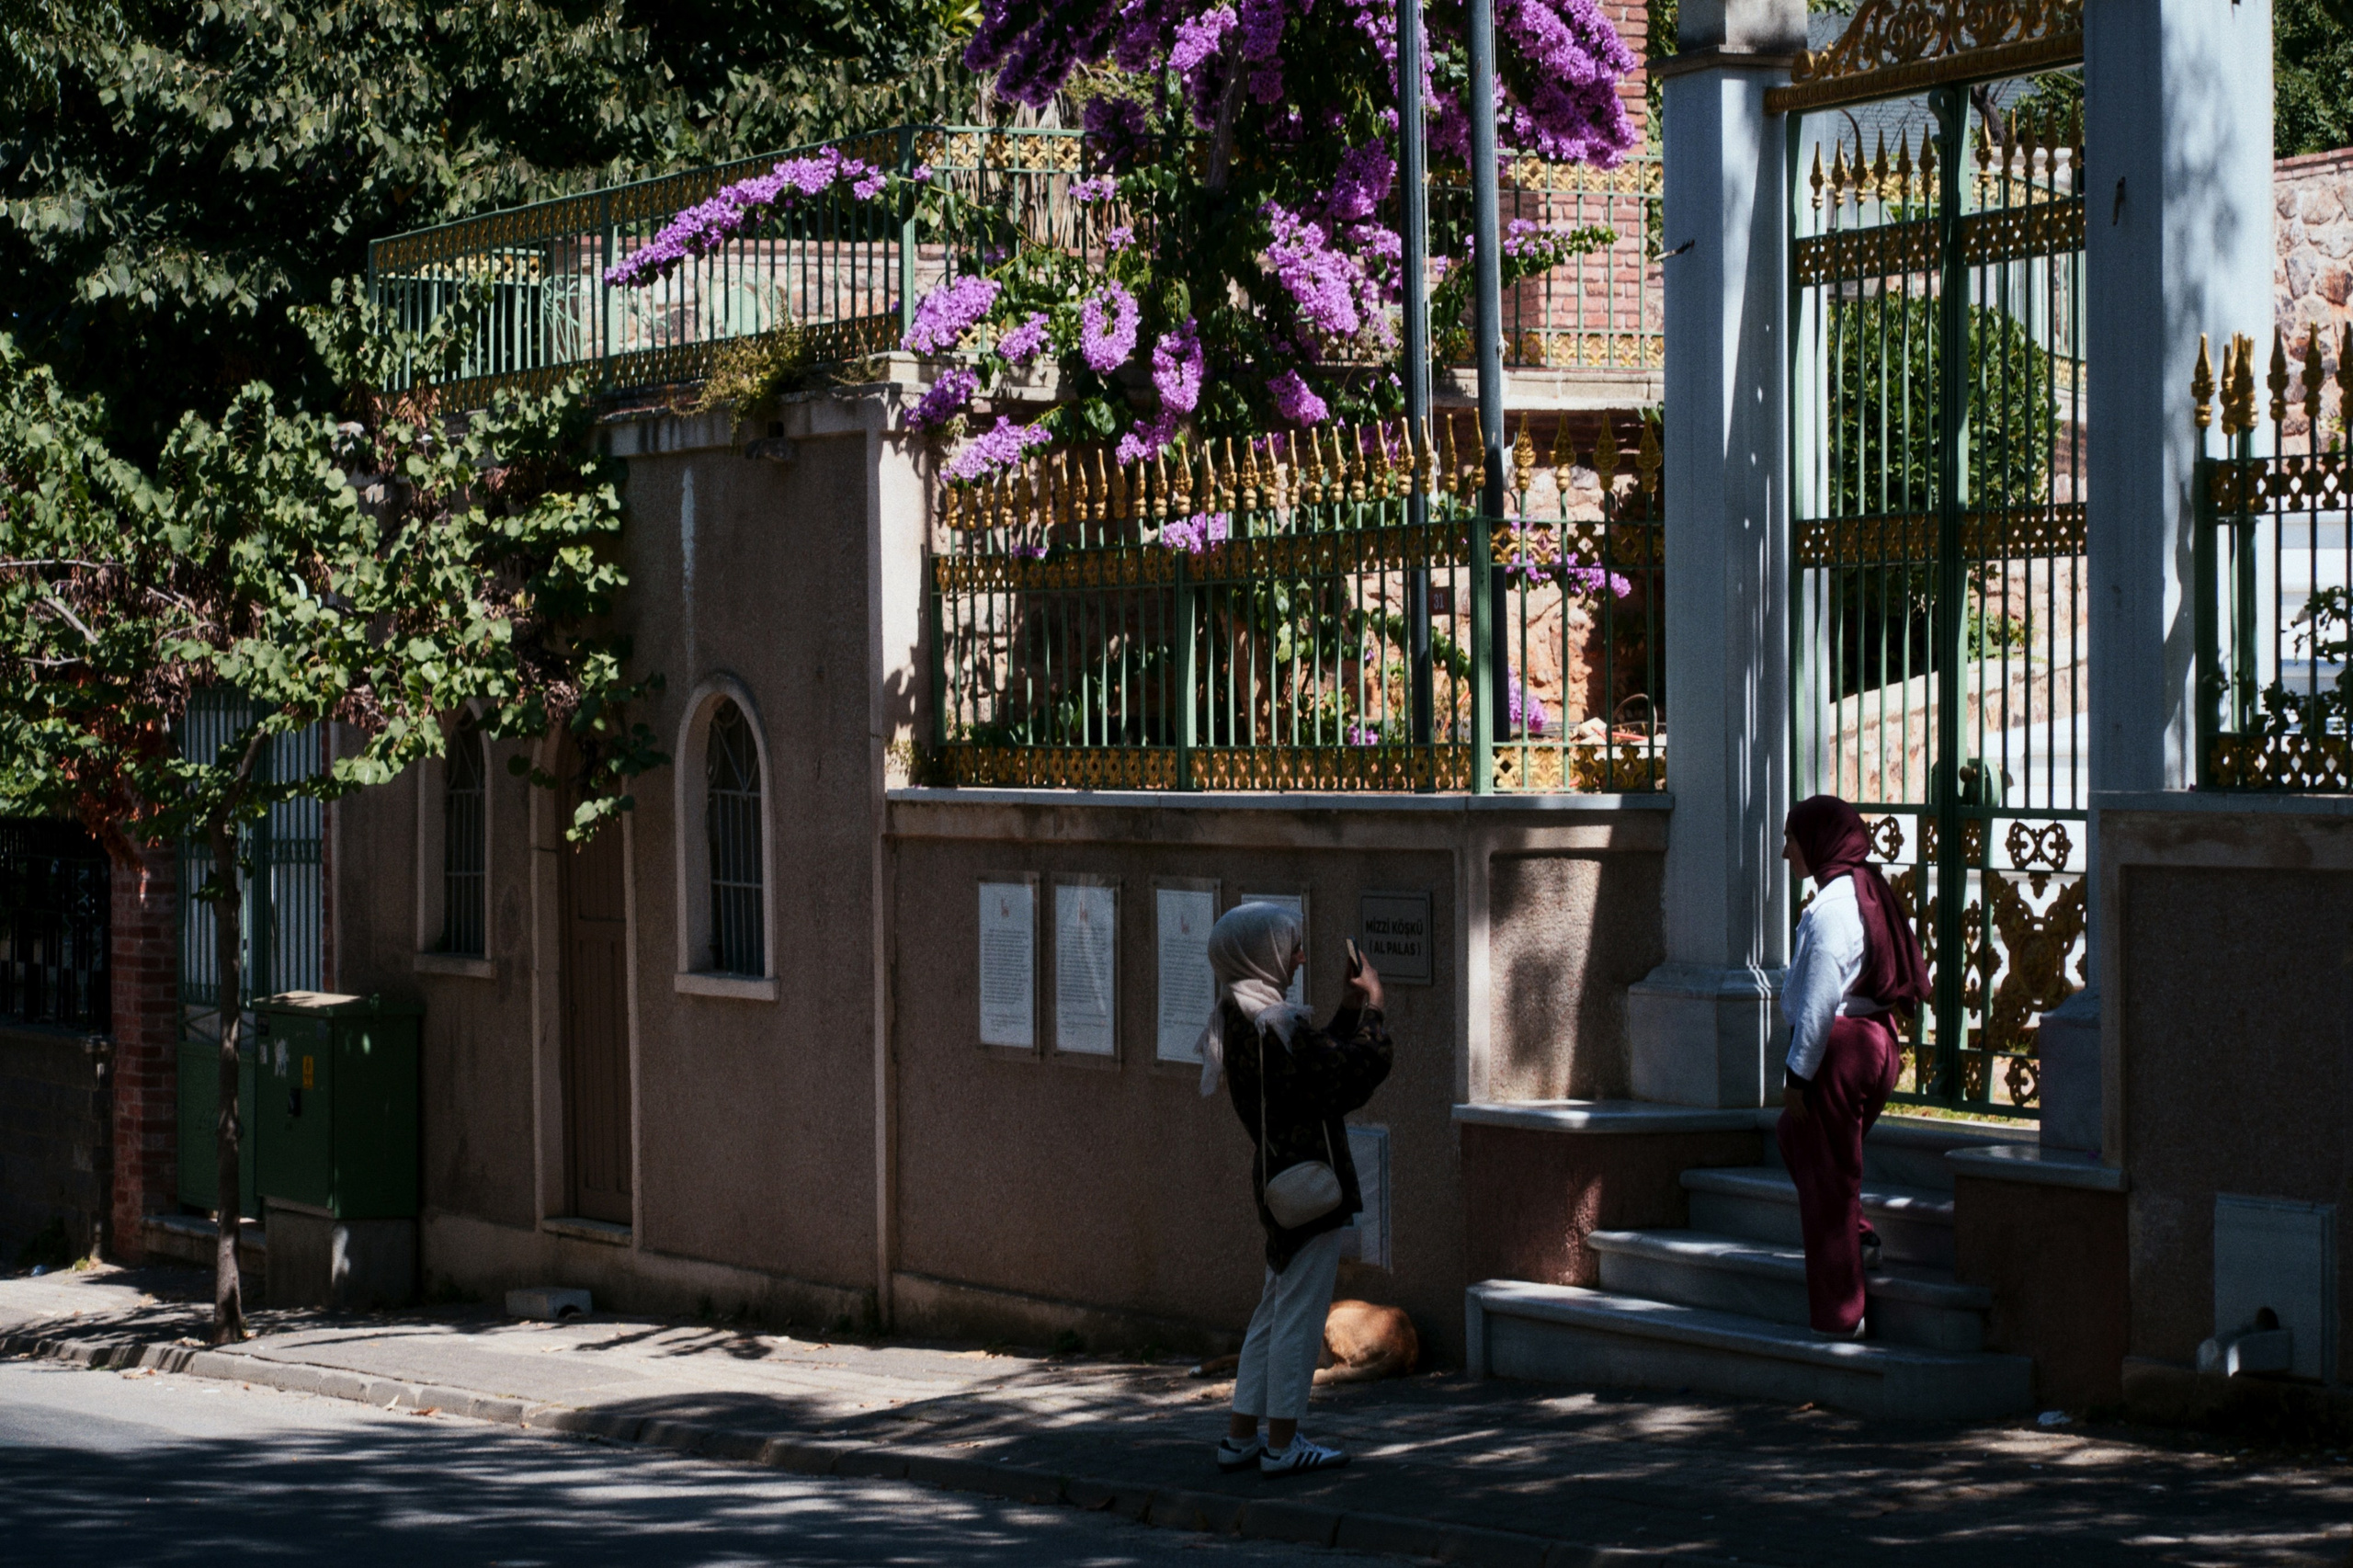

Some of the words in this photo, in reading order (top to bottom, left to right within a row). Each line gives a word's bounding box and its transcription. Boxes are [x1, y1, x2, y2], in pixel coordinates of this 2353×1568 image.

[1434, 593, 1445, 609] 31
[1365, 917, 1390, 934] MİZZİ
[1392, 918, 1424, 937] KÖŞKÜ
